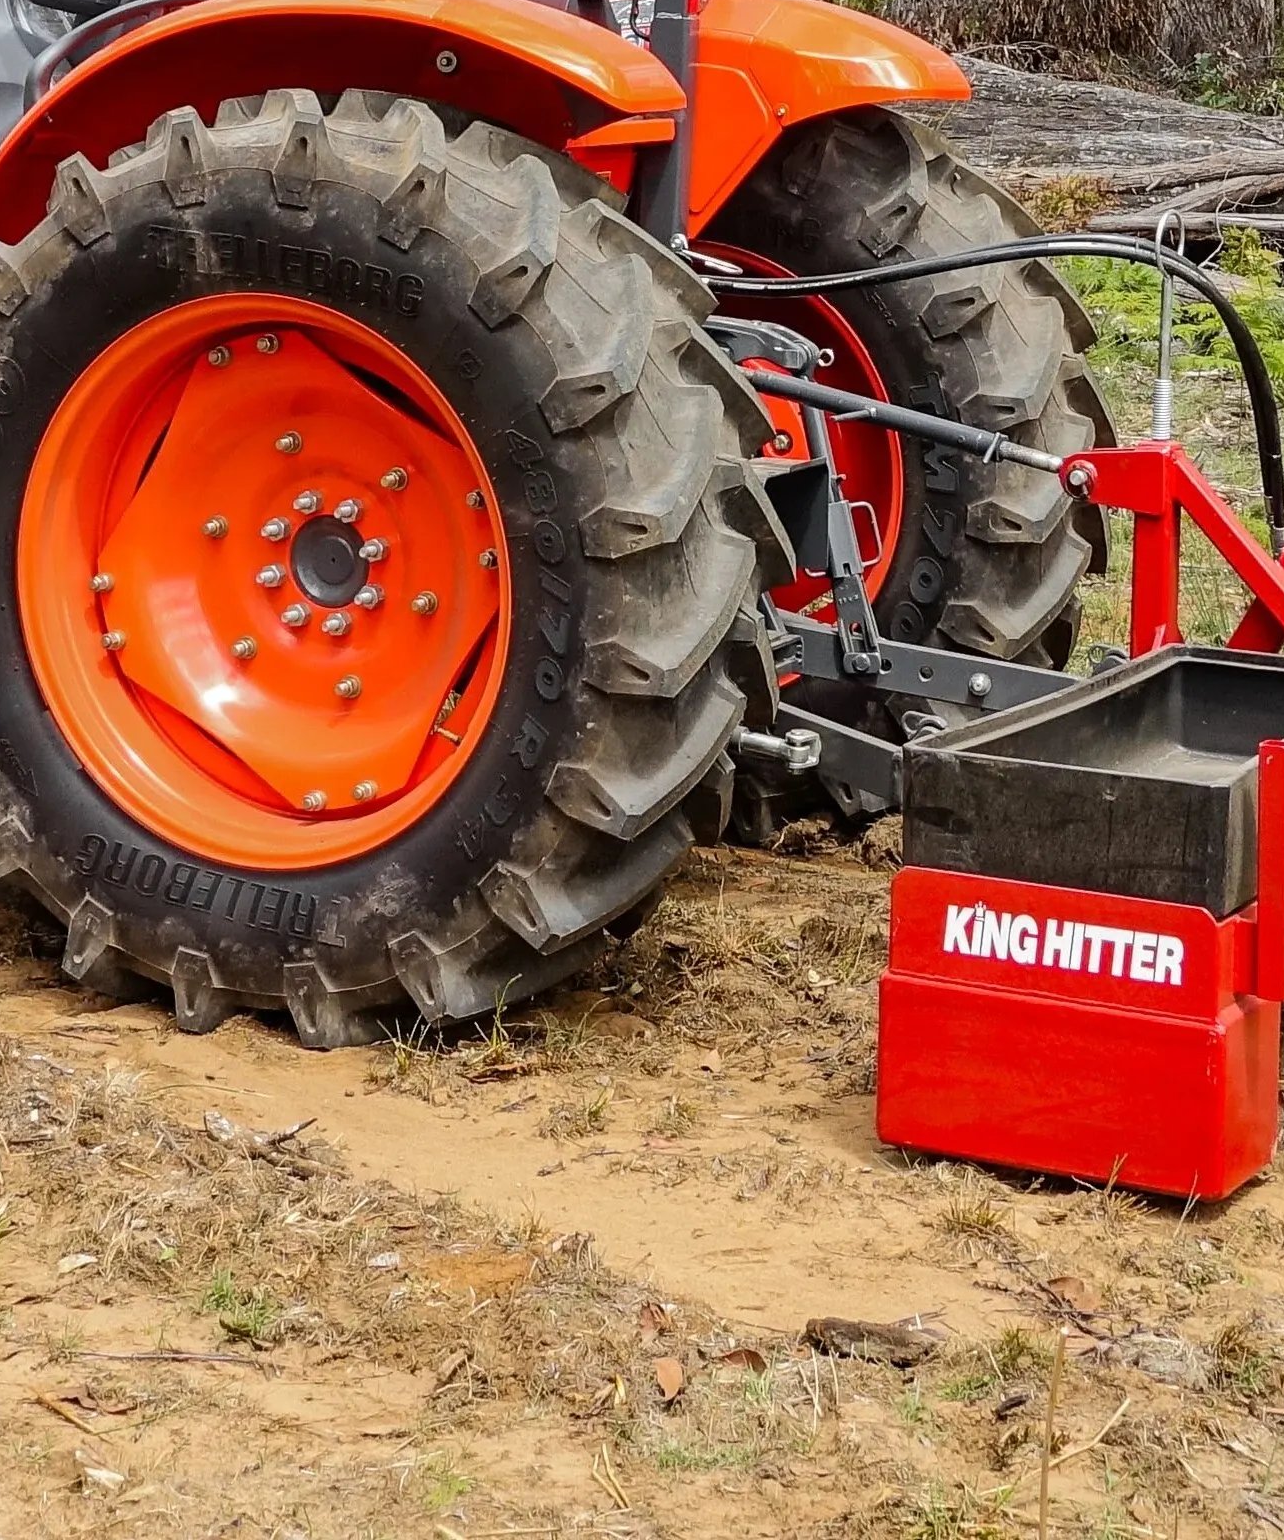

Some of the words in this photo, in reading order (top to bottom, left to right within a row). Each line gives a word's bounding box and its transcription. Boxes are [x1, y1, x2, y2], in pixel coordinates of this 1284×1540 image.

[140, 223, 427, 318] TRELLEBORG
[504, 428, 572, 704] 480/70
[511, 711, 550, 770] R
[71, 832, 347, 949] TRELLEBORG
[1042, 918, 1185, 986] HITTER
